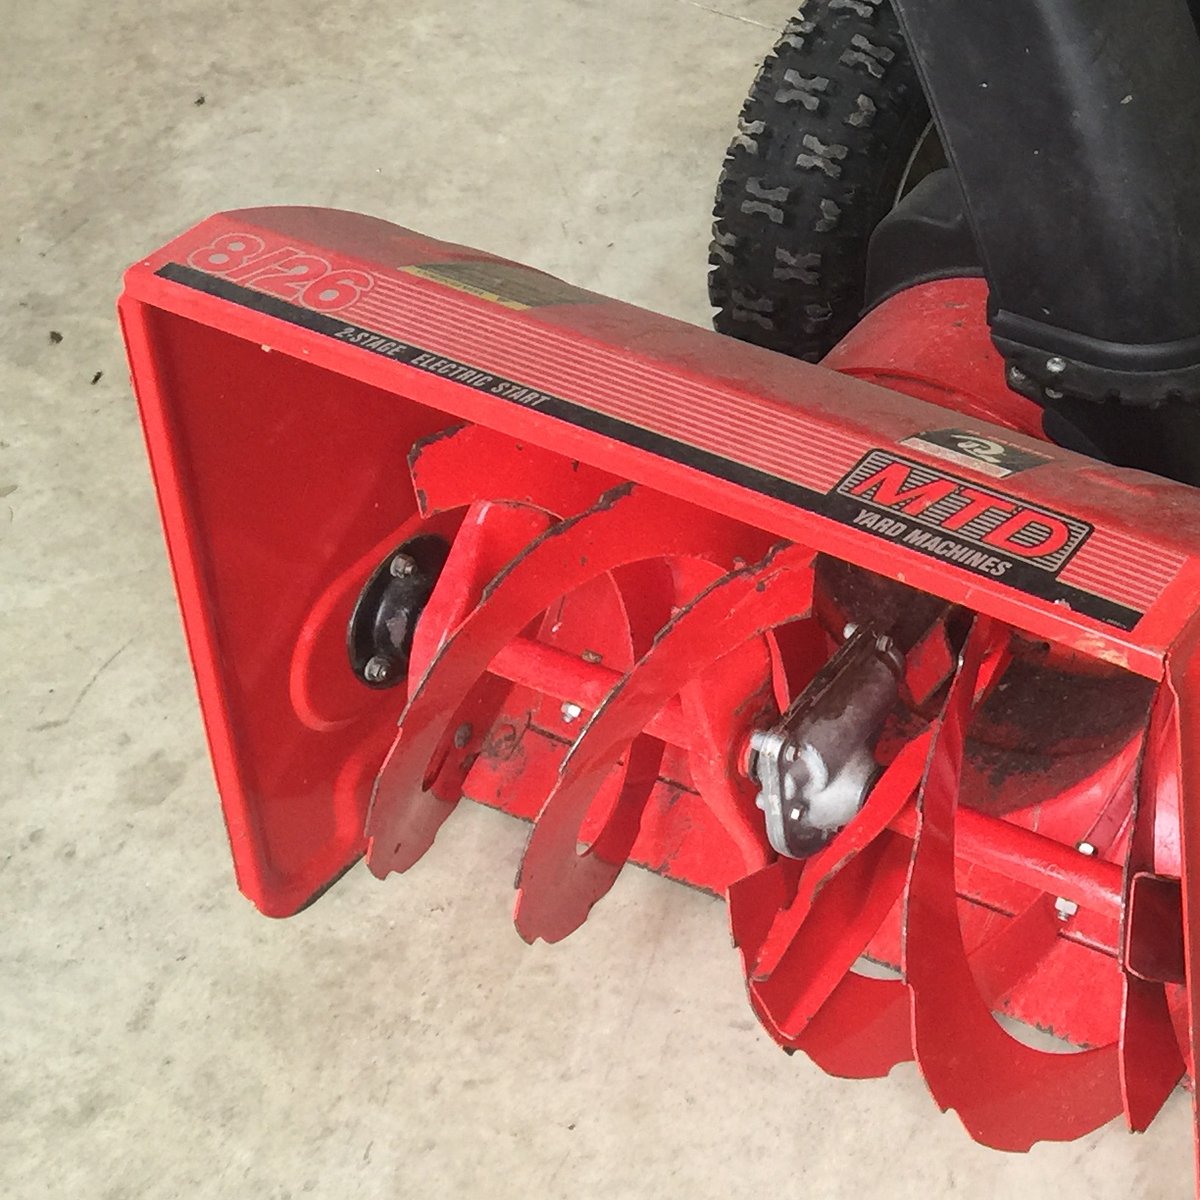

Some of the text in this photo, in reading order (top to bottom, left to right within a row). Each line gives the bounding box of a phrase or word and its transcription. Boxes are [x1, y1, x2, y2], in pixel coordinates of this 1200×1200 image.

[187, 233, 375, 314] 8/26
[333, 326, 551, 408] 2-STAGE ELECTRIC START
[850, 460, 1071, 558] MTD
[851, 508, 1013, 577] YARD MACHINES
